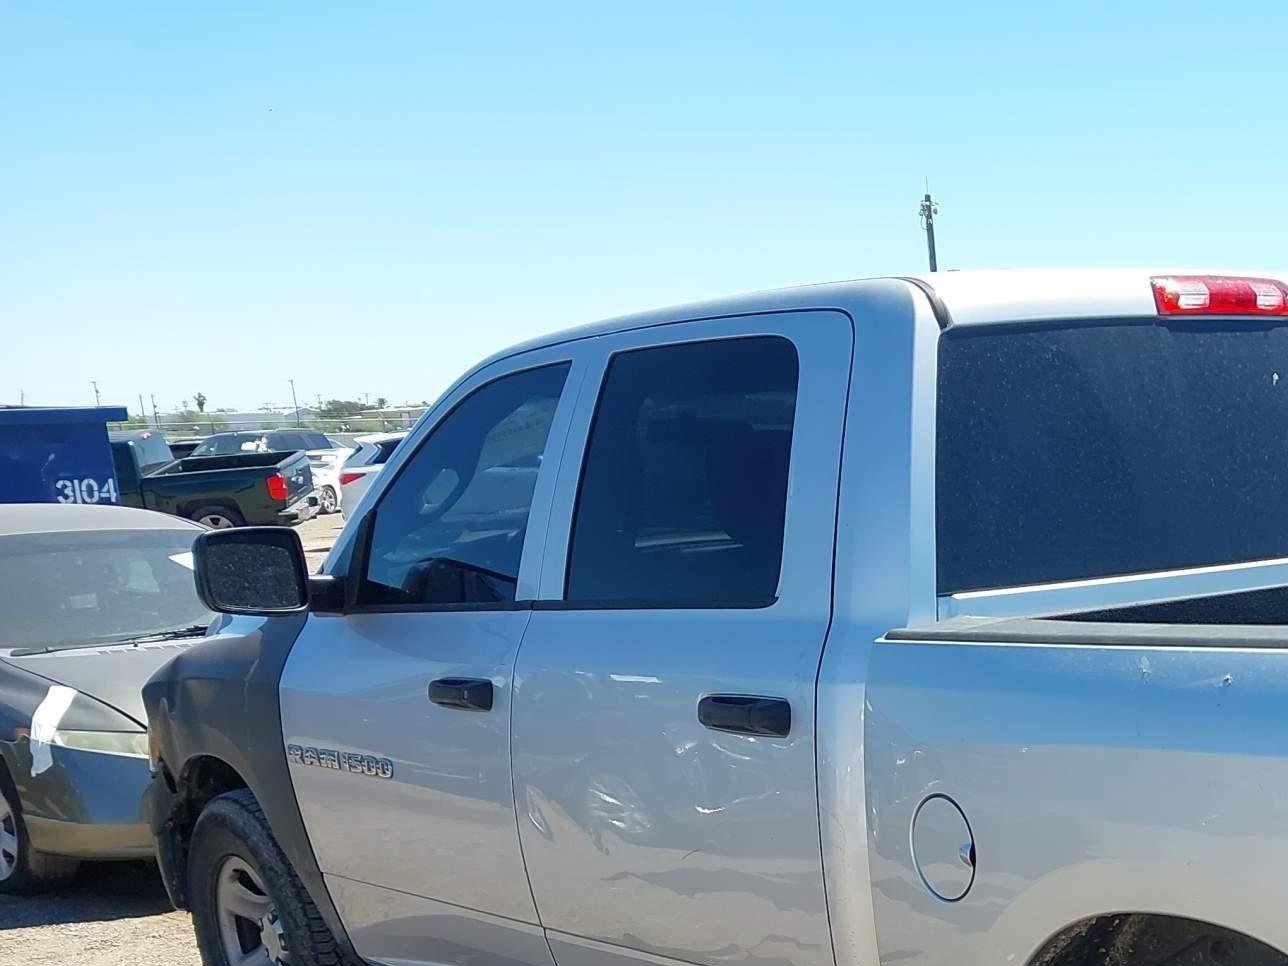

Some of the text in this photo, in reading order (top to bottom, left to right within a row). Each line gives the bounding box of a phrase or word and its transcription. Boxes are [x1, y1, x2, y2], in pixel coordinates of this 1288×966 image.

[55, 478, 117, 504] 3104
[287, 744, 394, 779] RAM 1500
